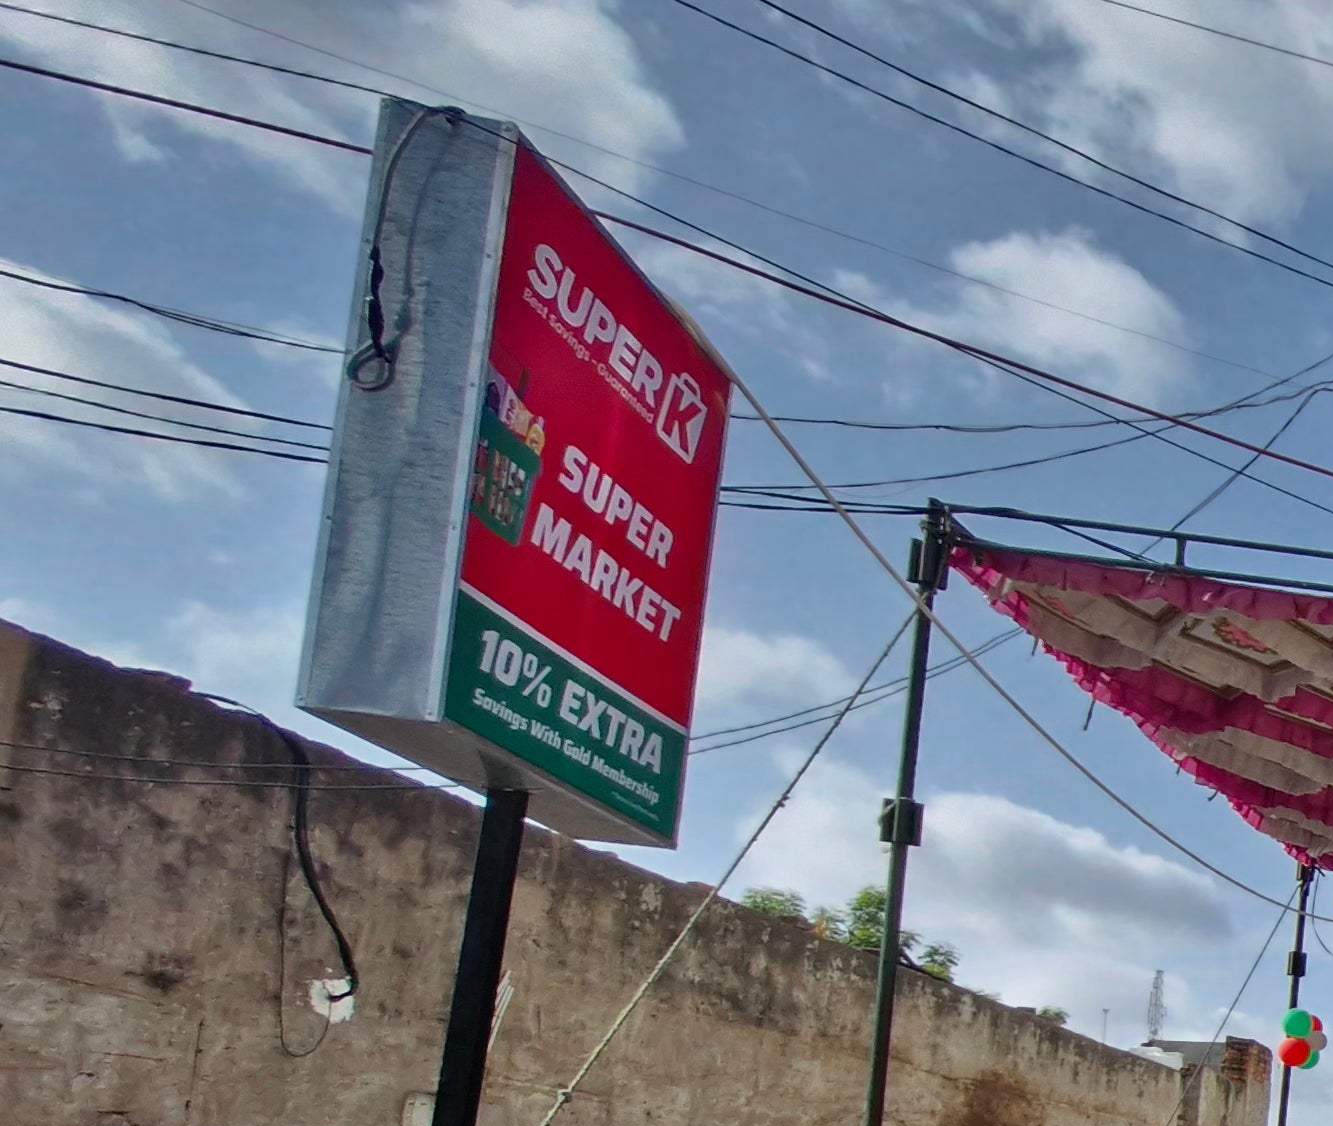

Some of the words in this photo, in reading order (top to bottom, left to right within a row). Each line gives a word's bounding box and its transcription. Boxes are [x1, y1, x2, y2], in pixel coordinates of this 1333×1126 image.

[531, 502, 682, 642] MARKET
[557, 445, 674, 569] SUPER
[472, 687, 529, 731] Savings
[530, 718, 563, 750] With
[562, 737, 592, 767] Gold
[590, 754, 660, 806] Membership
[479, 629, 553, 708] 10%
[558, 678, 664, 775] EXTRA
